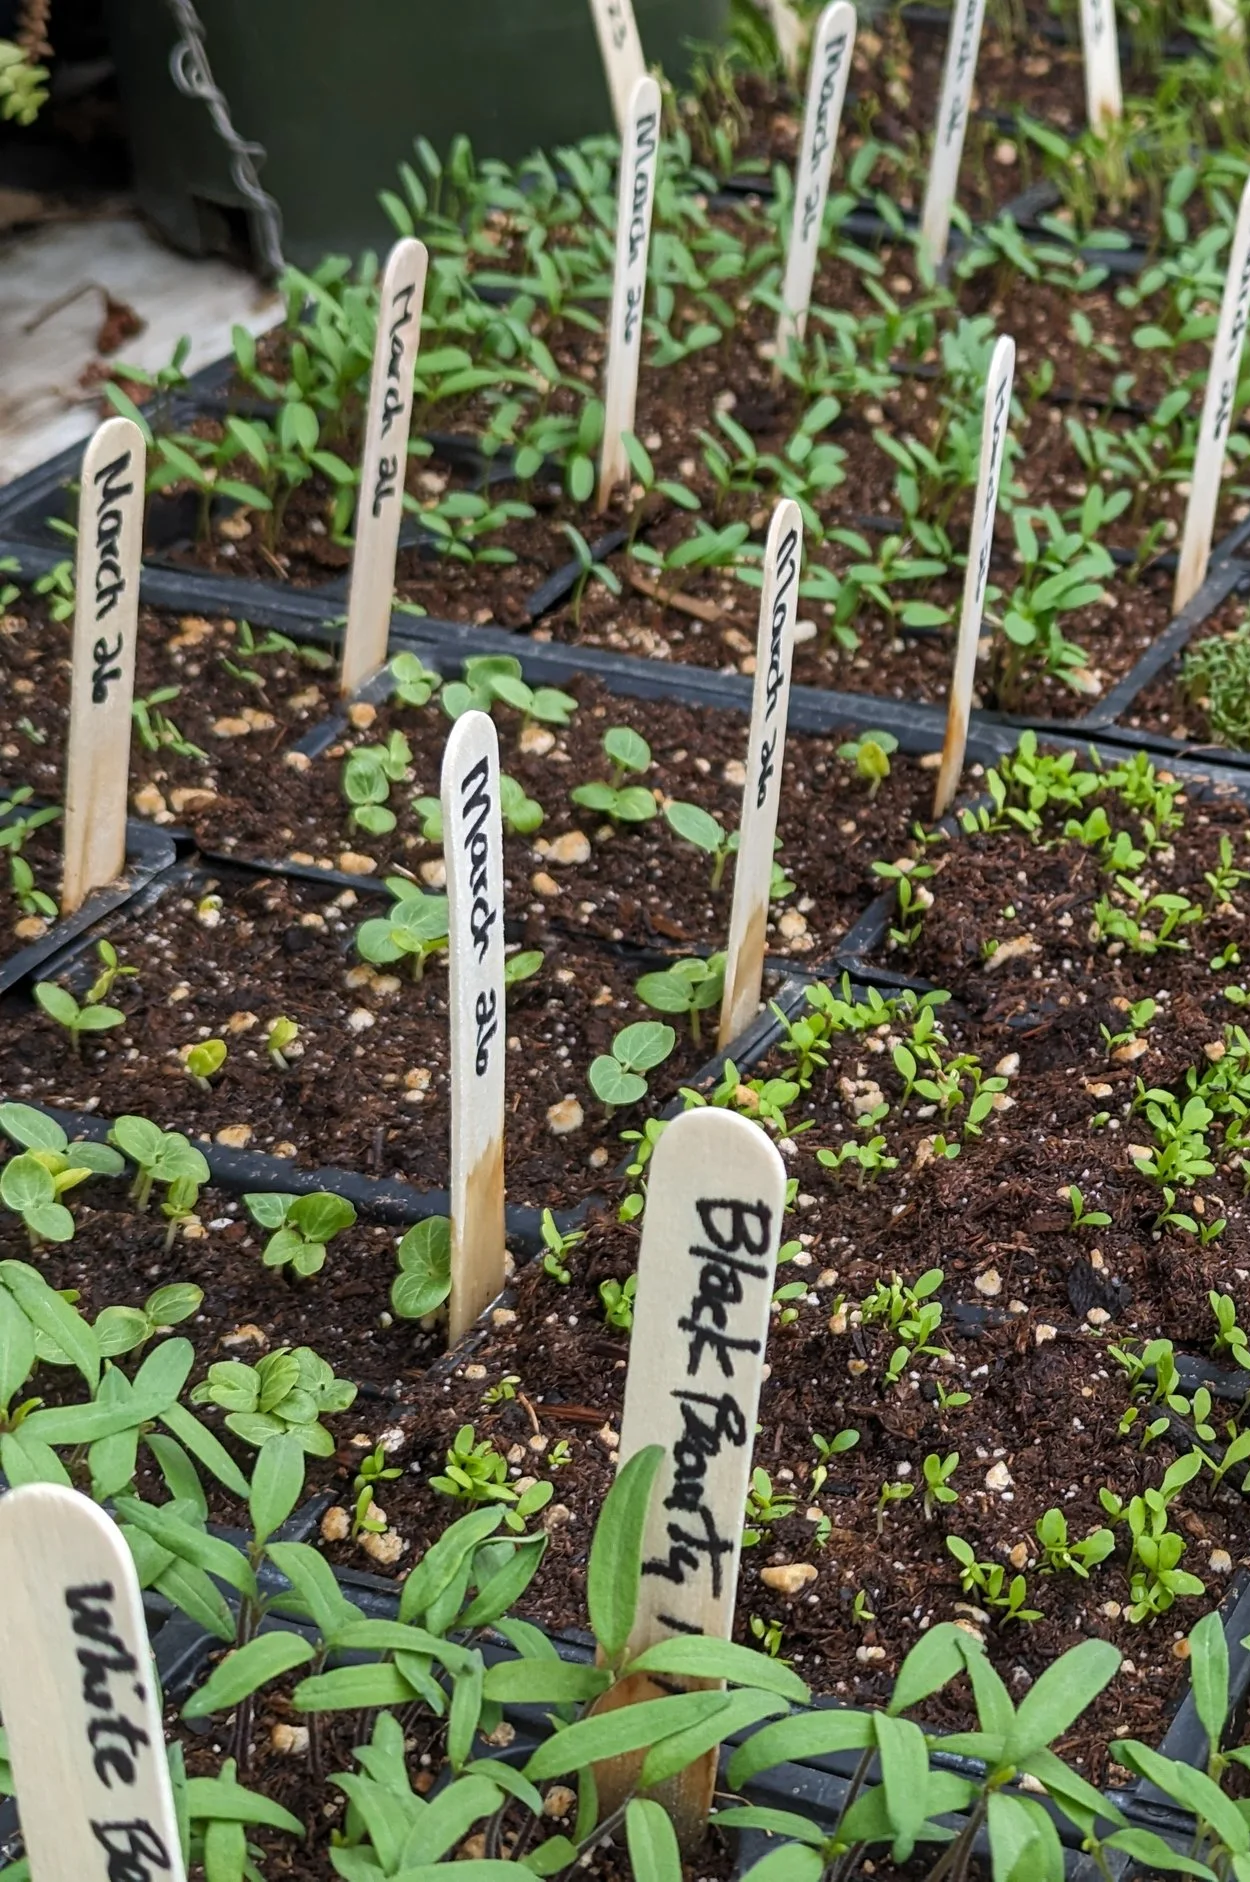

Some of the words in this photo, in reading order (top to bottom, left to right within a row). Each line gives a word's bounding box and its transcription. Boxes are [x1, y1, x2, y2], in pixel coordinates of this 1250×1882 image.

[630, 112, 656, 266] March
[382, 283, 414, 440] March
[95, 450, 133, 621] March
[92, 633, 123, 703] 26
[765, 529, 796, 724] March
[757, 728, 777, 809] 26
[461, 756, 496, 963] March
[475, 988, 496, 1076] 26
[679, 1198, 772, 1377] Black
[66, 1581, 149, 1789] White
